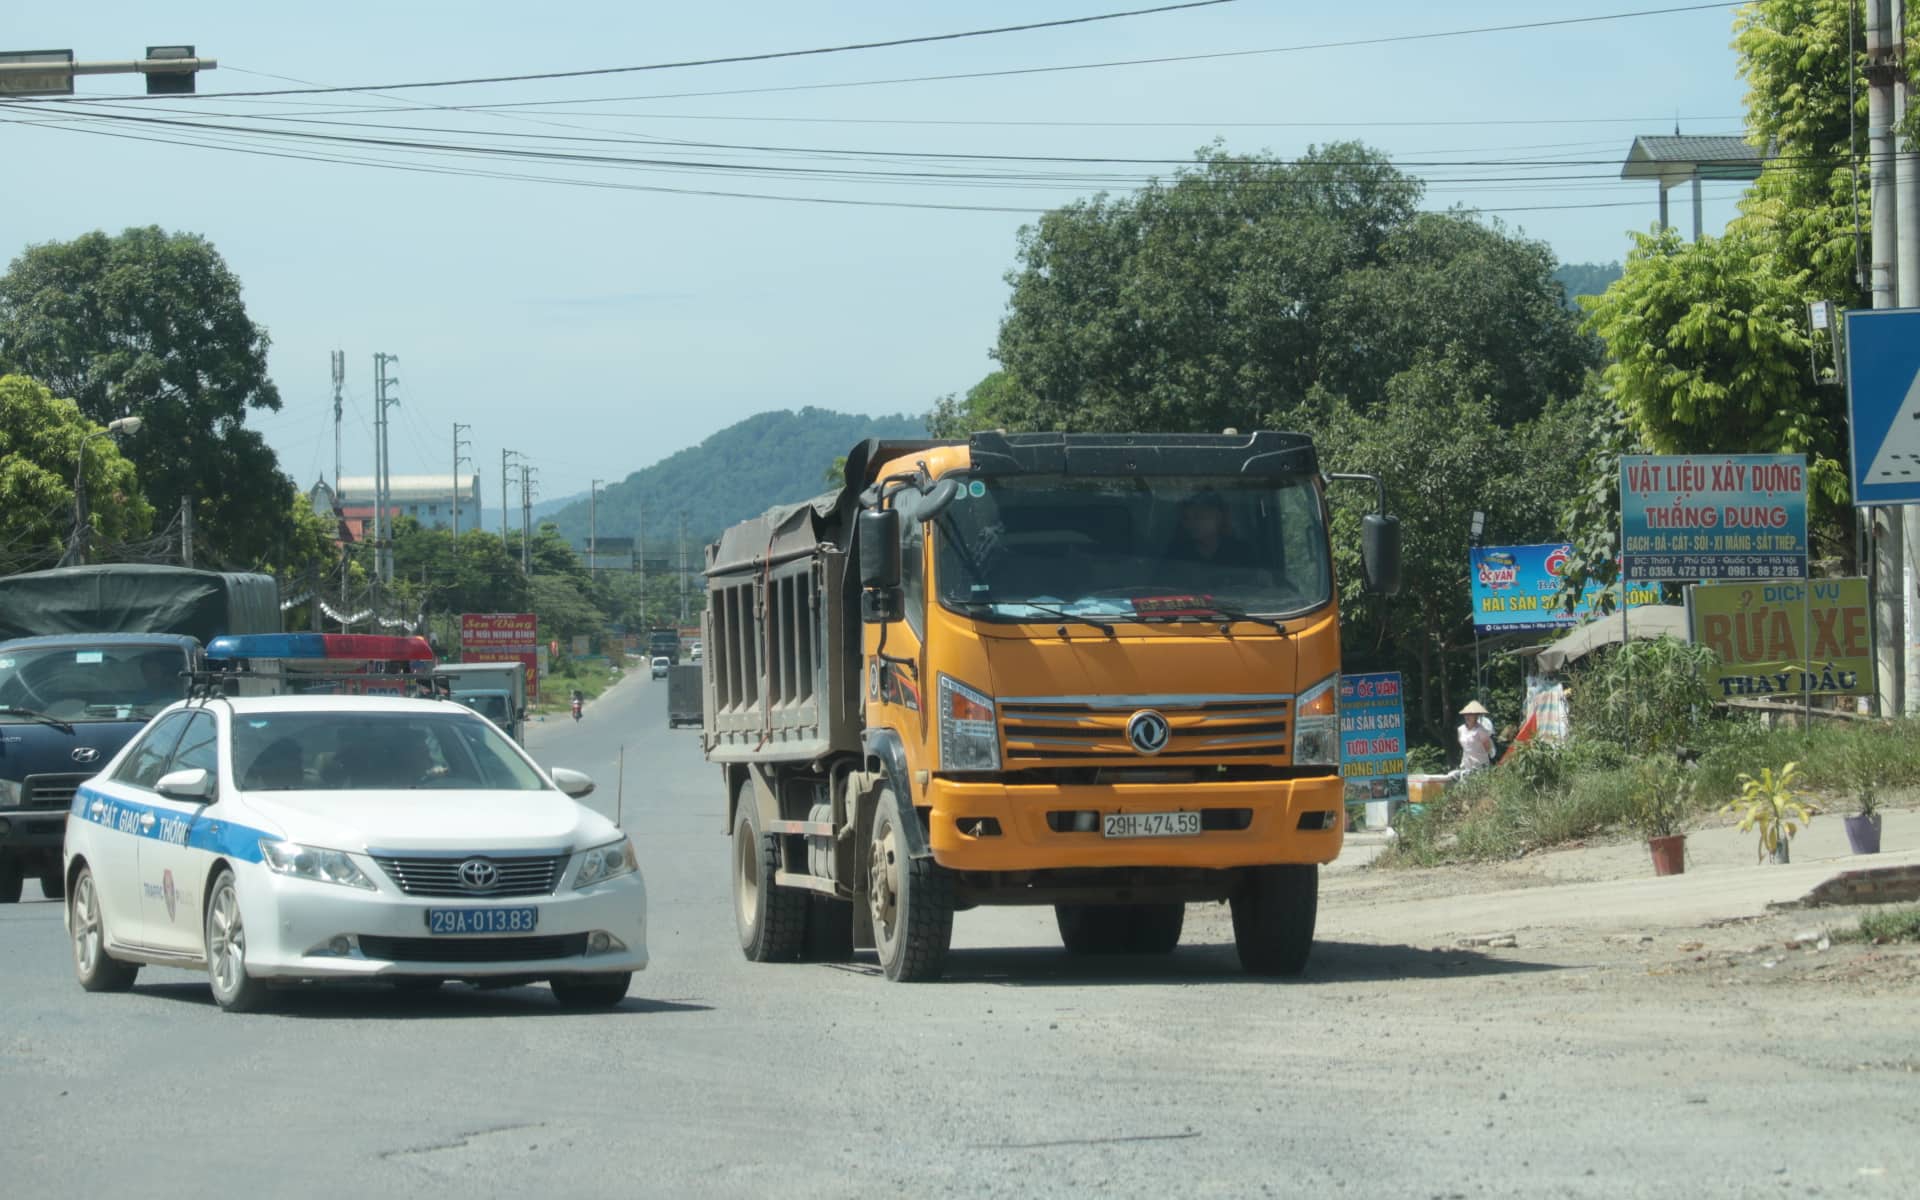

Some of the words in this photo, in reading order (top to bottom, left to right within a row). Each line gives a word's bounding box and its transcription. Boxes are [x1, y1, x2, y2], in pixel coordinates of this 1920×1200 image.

[1628, 460, 1662, 498] VẬT
[1666, 459, 1705, 498] LIỆU
[1711, 459, 1746, 493] XÂY
[1752, 463, 1802, 498] DỰNG
[1645, 496, 1718, 528] THẮNG
[1723, 506, 1788, 528] DUNG
[1626, 535, 1650, 555] GẠCH
[1678, 566, 1697, 577] 472
[1772, 565, 1785, 576] 22
[1482, 591, 1505, 612] HẢI
[1510, 590, 1537, 610] SẢN
[1763, 586, 1807, 607] DỊCH
[1814, 583, 1840, 604] VỤ
[1703, 590, 1797, 664] RỬA
[1811, 606, 1869, 660] XE
[1358, 678, 1374, 697] ỐC
[1375, 678, 1398, 696] VÂN
[1718, 673, 1792, 697] THAY
[1356, 710, 1375, 730] SẢN
[1371, 733, 1399, 753] SỐNG
[119, 808, 140, 837] GIAO
[1105, 814, 1199, 836] 29H-474.59
[433, 910, 534, 932] 29A-013.83
